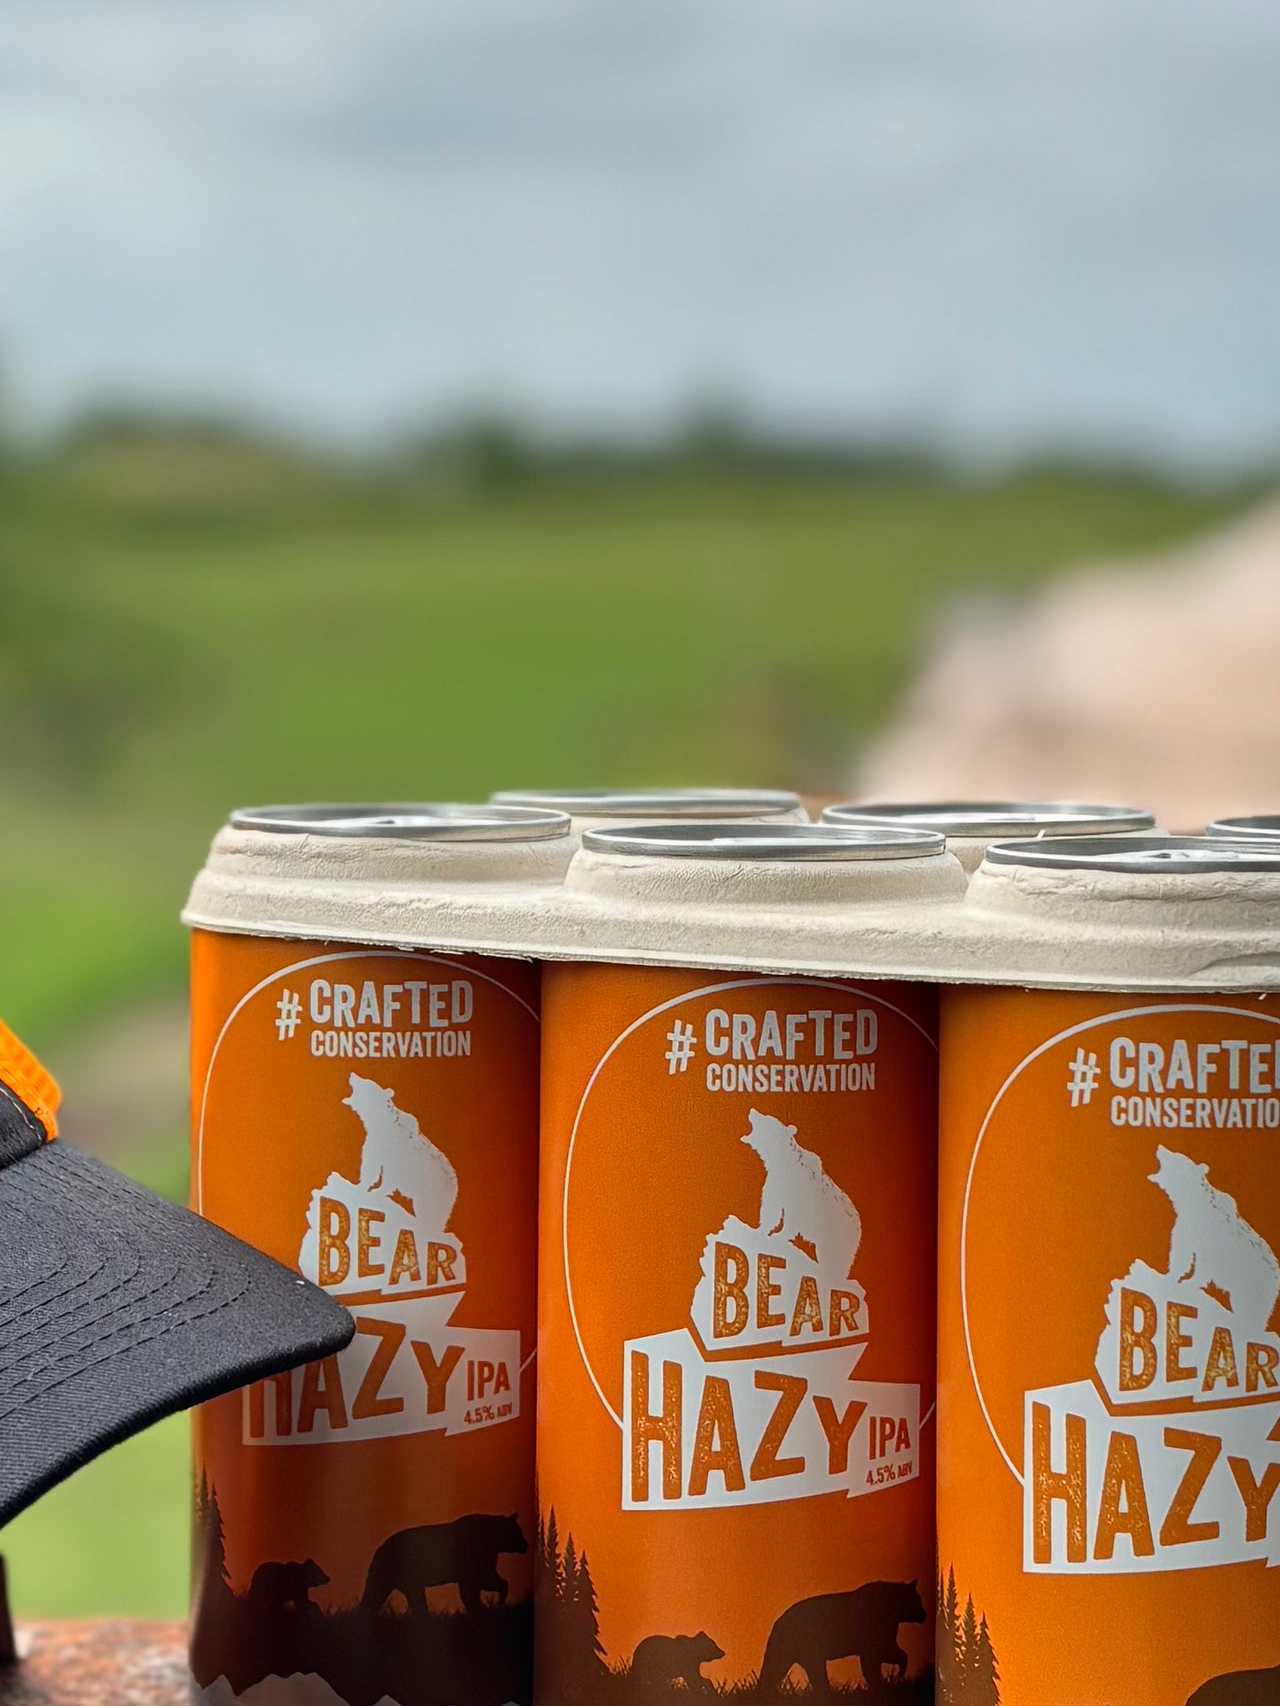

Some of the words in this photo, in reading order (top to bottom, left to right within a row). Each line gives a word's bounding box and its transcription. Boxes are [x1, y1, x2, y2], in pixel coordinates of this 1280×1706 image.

[310, 1030, 472, 1058] CONSERVATION
[705, 1063, 876, 1093] CONSERVATION
[318, 1195, 458, 1286] BEAR
[713, 1241, 861, 1339] BEAR
[1119, 1285, 1280, 1393] BEAR
[467, 1359, 511, 1402] IPA
[463, 1406, 495, 1426] 4.5%
[631, 1350, 868, 1503] HAZY
[869, 1416, 911, 1460] IPA
[866, 1463, 896, 1486] 4.5%
